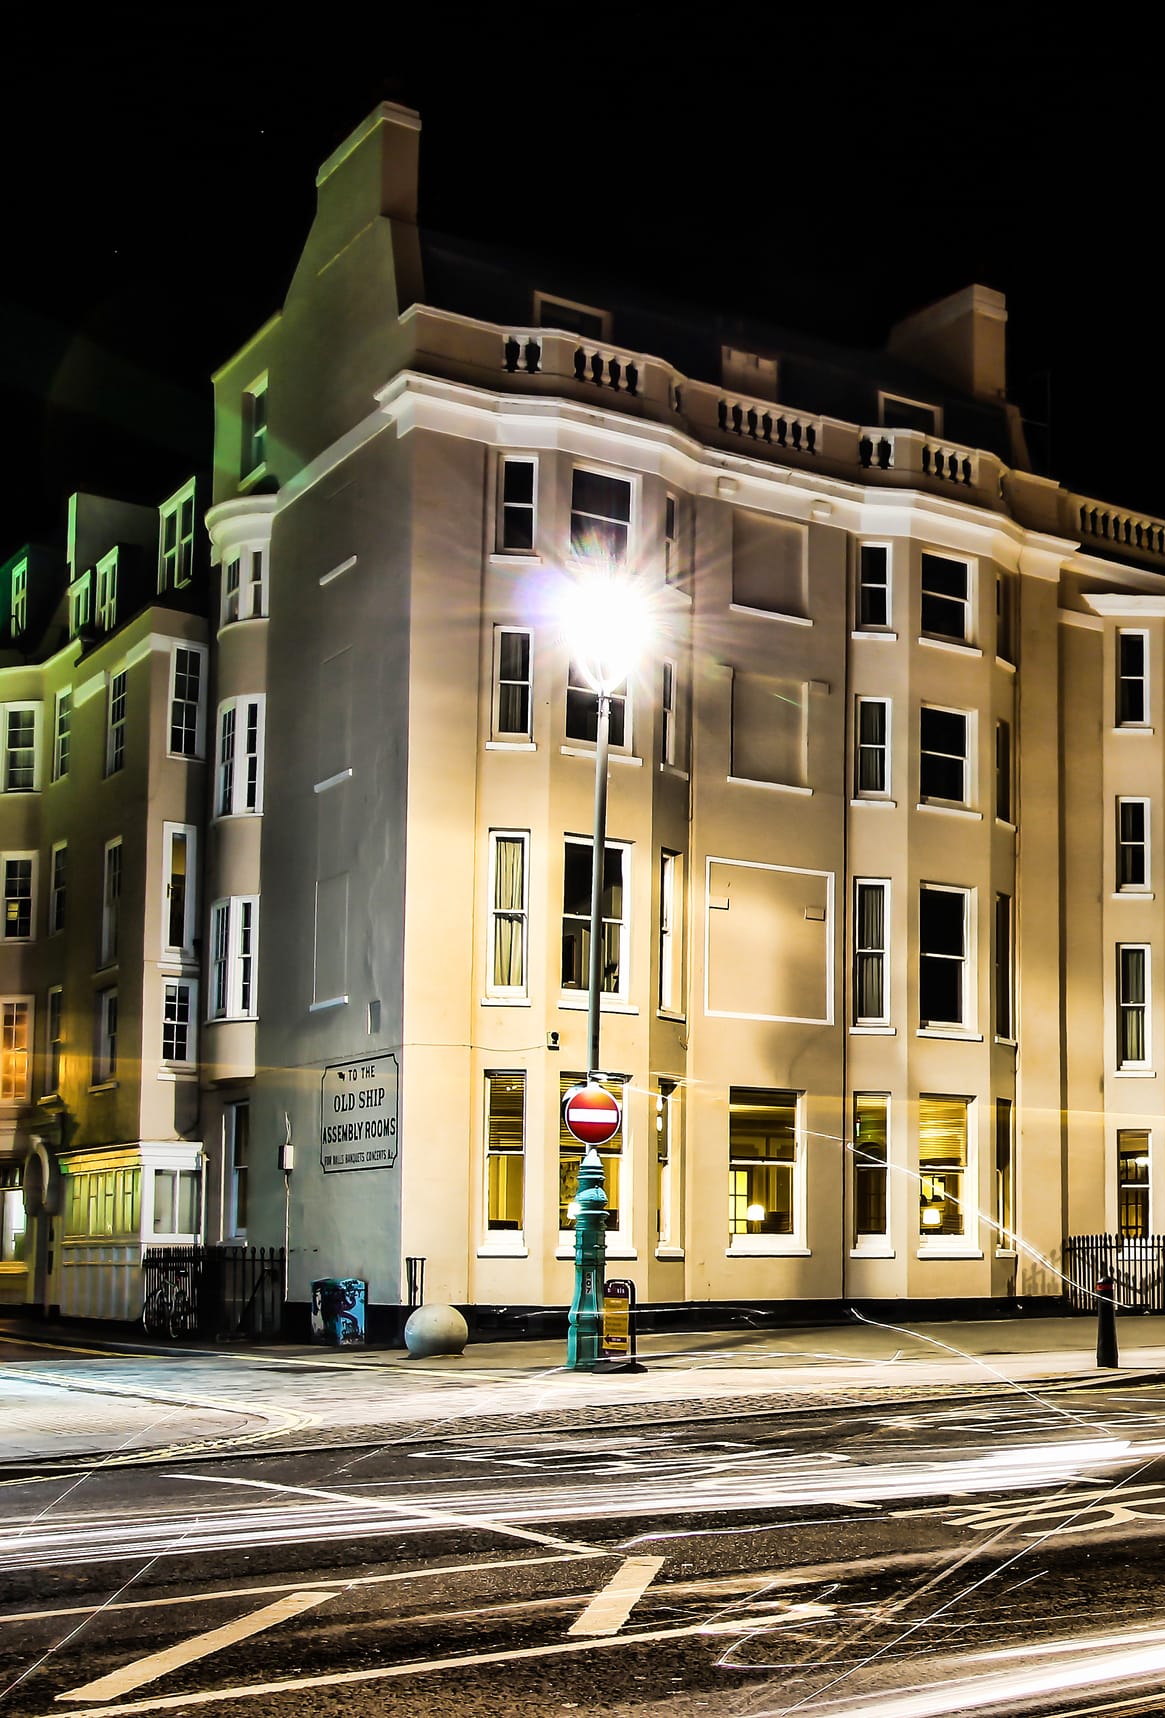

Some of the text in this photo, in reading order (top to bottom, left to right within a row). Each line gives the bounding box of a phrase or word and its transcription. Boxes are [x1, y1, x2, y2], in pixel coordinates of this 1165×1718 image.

[348, 1065, 375, 1081] TO THE
[333, 1087, 385, 1113] OLD SHIP
[322, 1117, 396, 1145] ASSEMBLY ROOMS
[324, 1155, 332, 1166] FOR
[366, 1149, 387, 1162] CONCERTS
[407, 1437, 851, 1481] CLEAR
